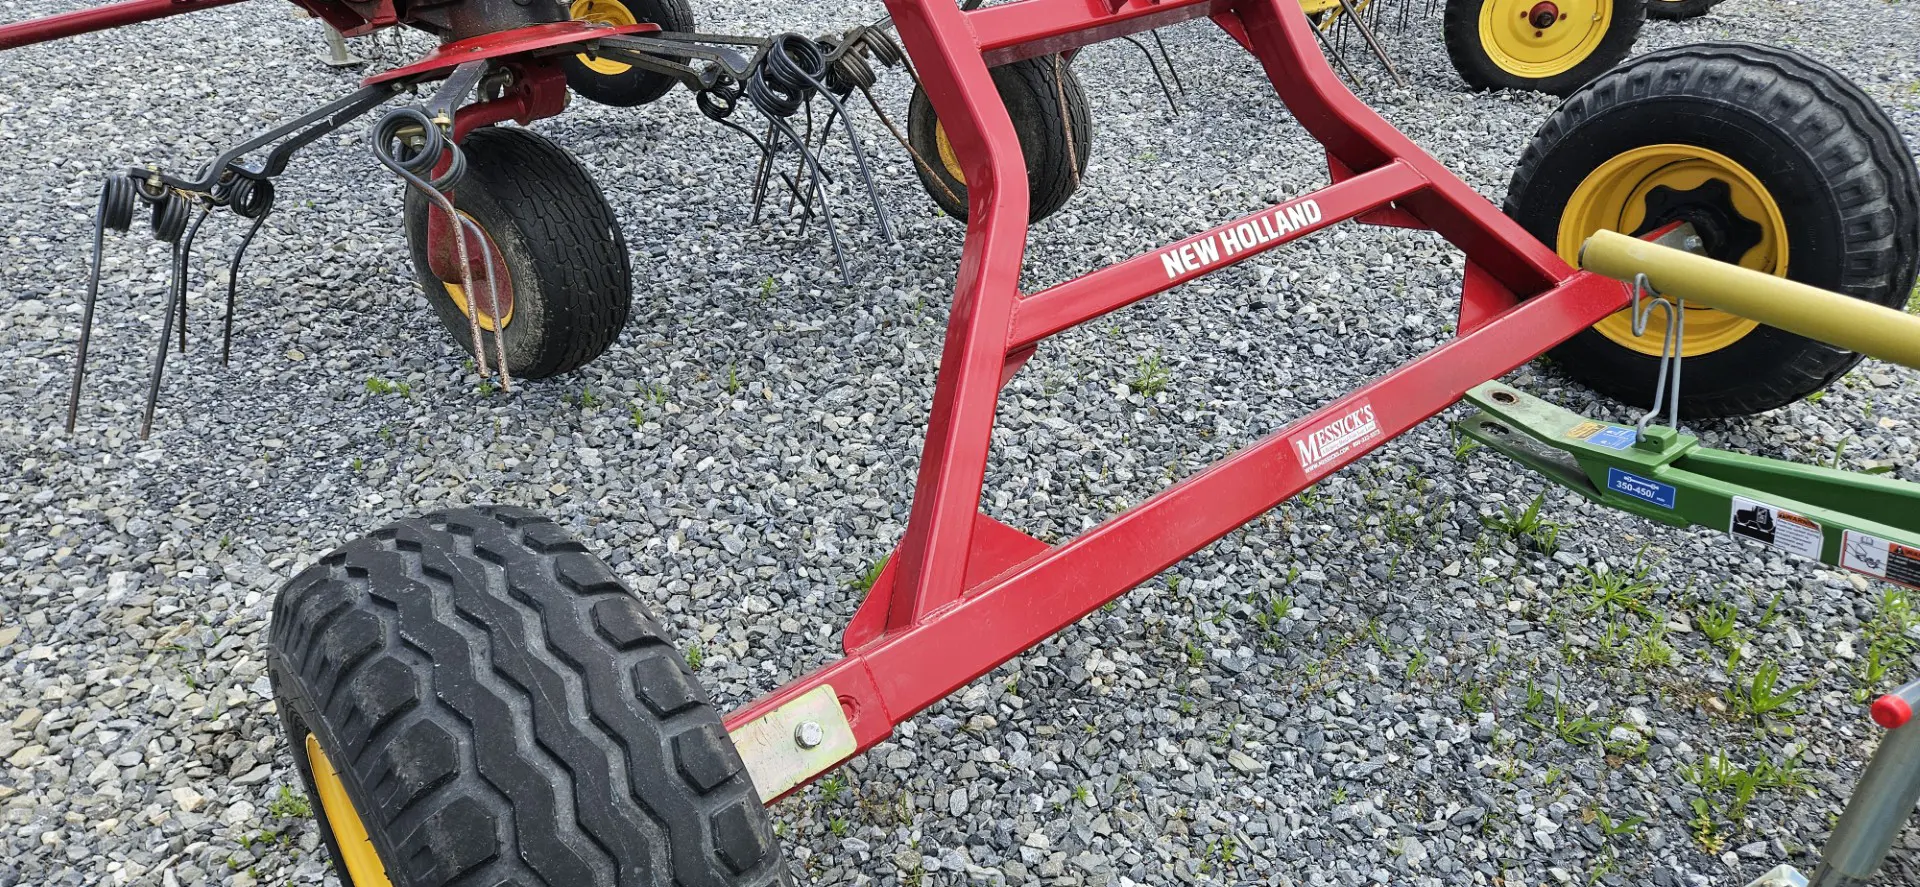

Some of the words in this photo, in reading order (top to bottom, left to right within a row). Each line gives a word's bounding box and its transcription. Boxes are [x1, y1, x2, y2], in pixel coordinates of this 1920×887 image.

[1160, 236, 1220, 279] NEW
[1219, 199, 1322, 256] HOLLAND
[1296, 404, 1374, 467] MESSICK'S
